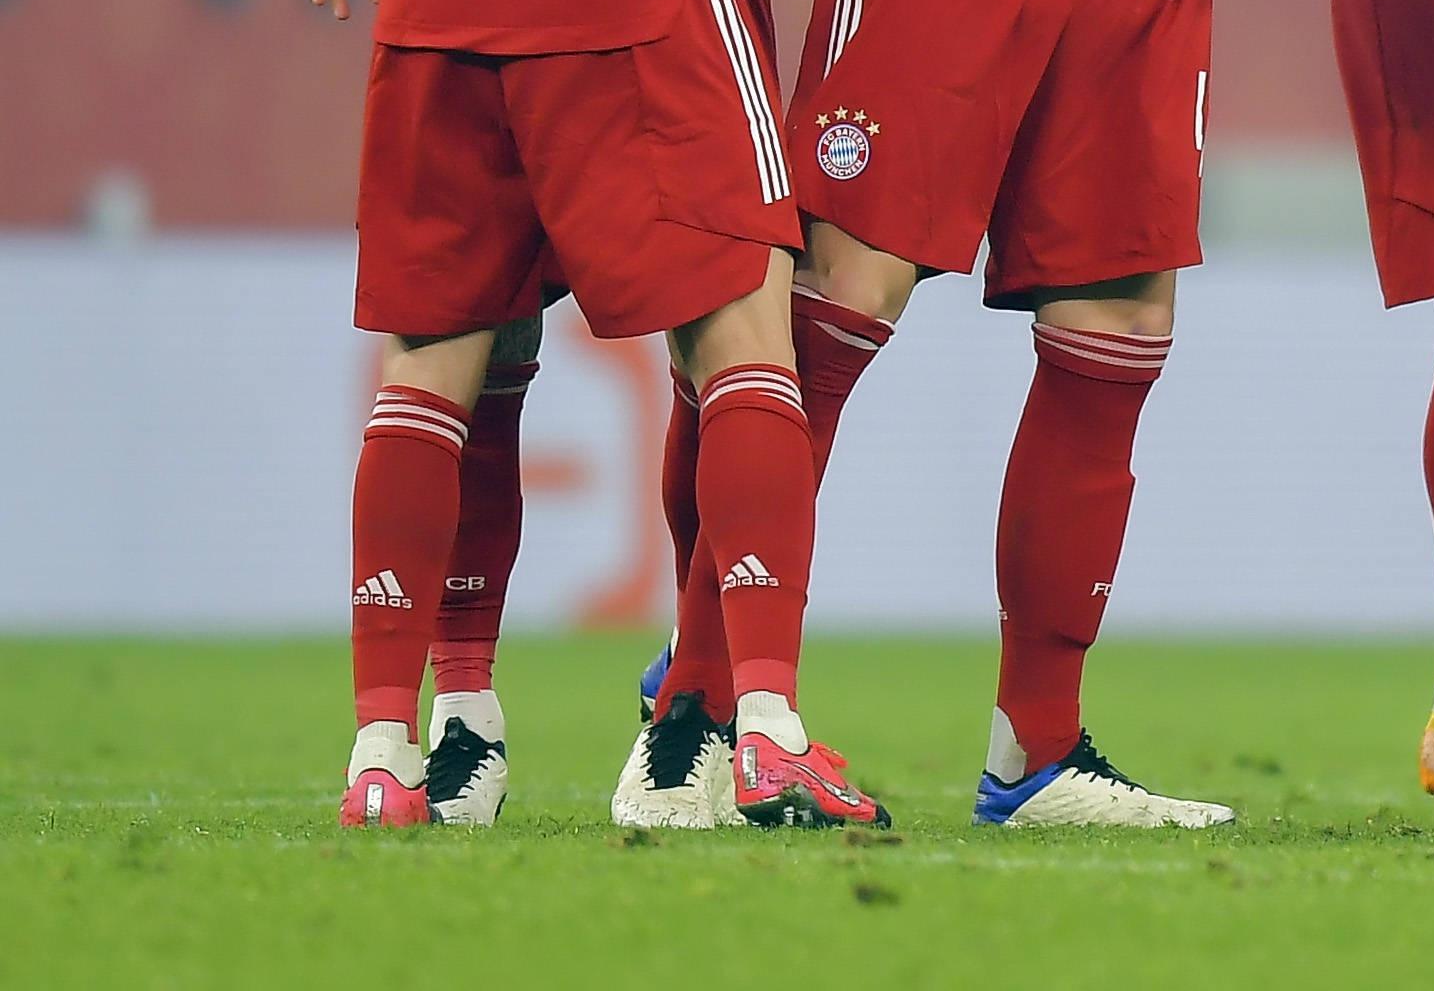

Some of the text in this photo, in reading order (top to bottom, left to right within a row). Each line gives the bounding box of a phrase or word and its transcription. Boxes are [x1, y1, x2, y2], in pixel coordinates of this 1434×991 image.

[835, 128, 866, 152] BAYERN
[445, 575, 486, 591] CB
[1090, 582, 1112, 597] FC
[352, 591, 413, 609] adidas
